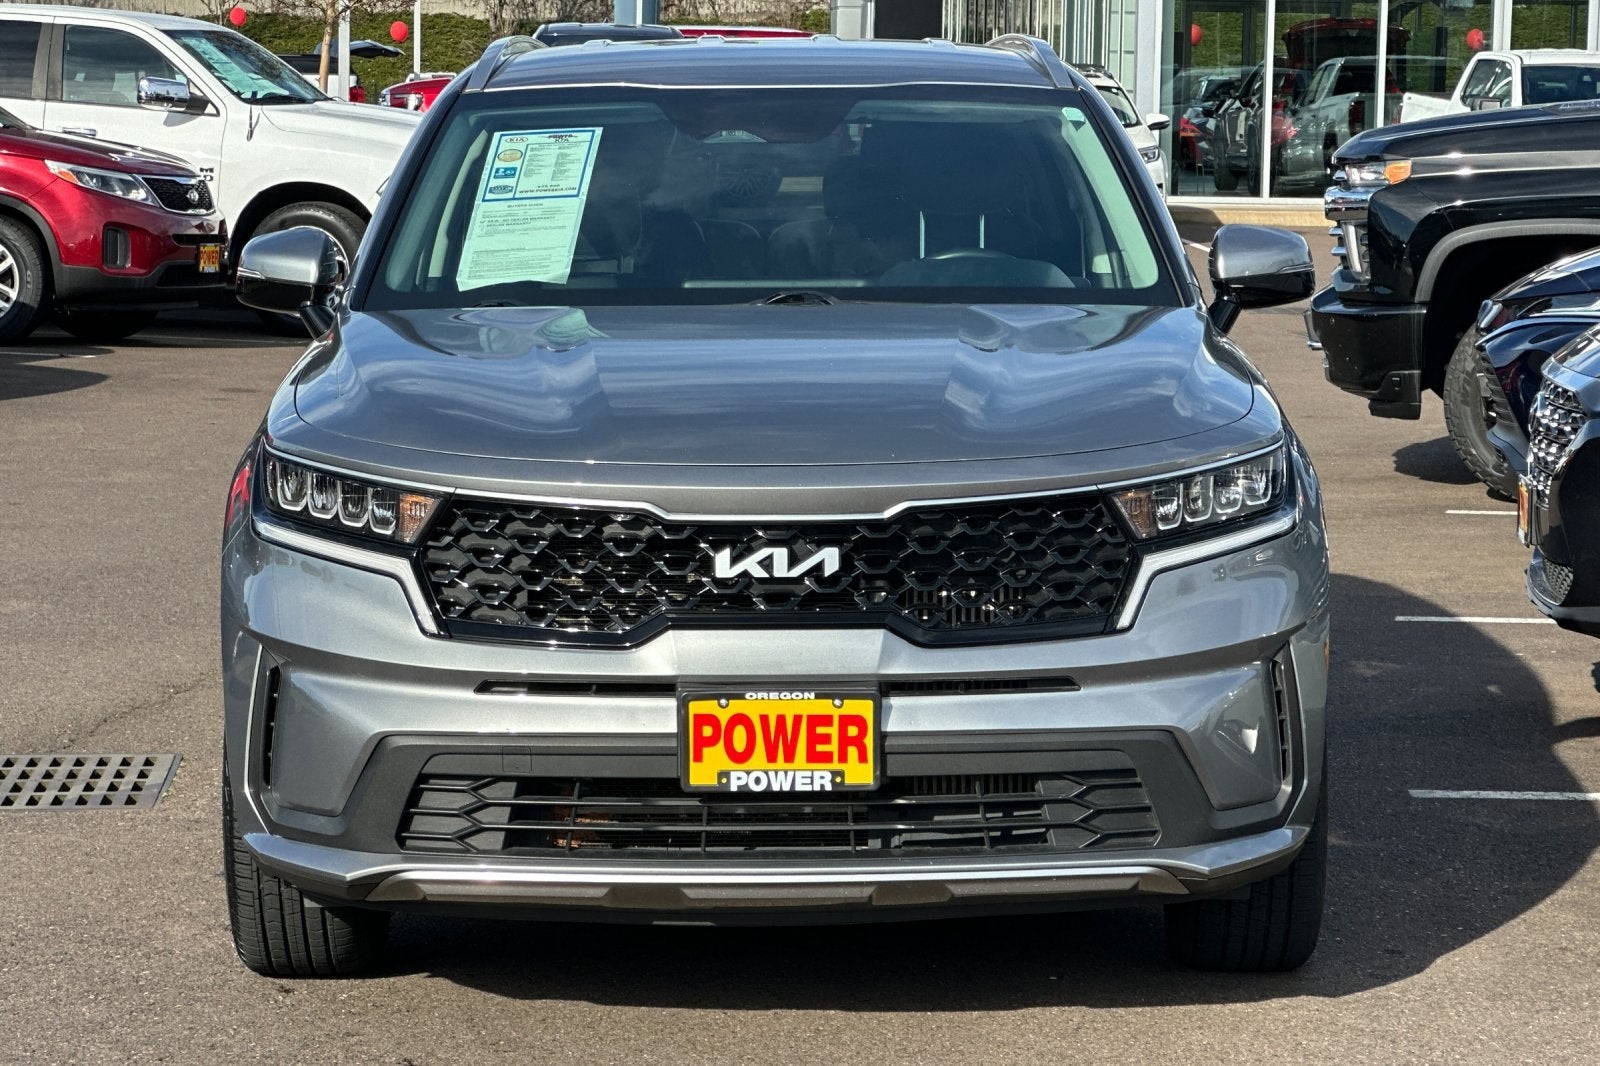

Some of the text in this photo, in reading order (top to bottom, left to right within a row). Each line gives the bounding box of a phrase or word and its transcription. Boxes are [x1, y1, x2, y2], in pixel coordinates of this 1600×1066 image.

[200, 249, 219, 265] POWER
[715, 547, 840, 578] KIA
[744, 692, 816, 700] OREGON
[692, 713, 869, 765] POWER
[730, 771, 833, 792] POWER
